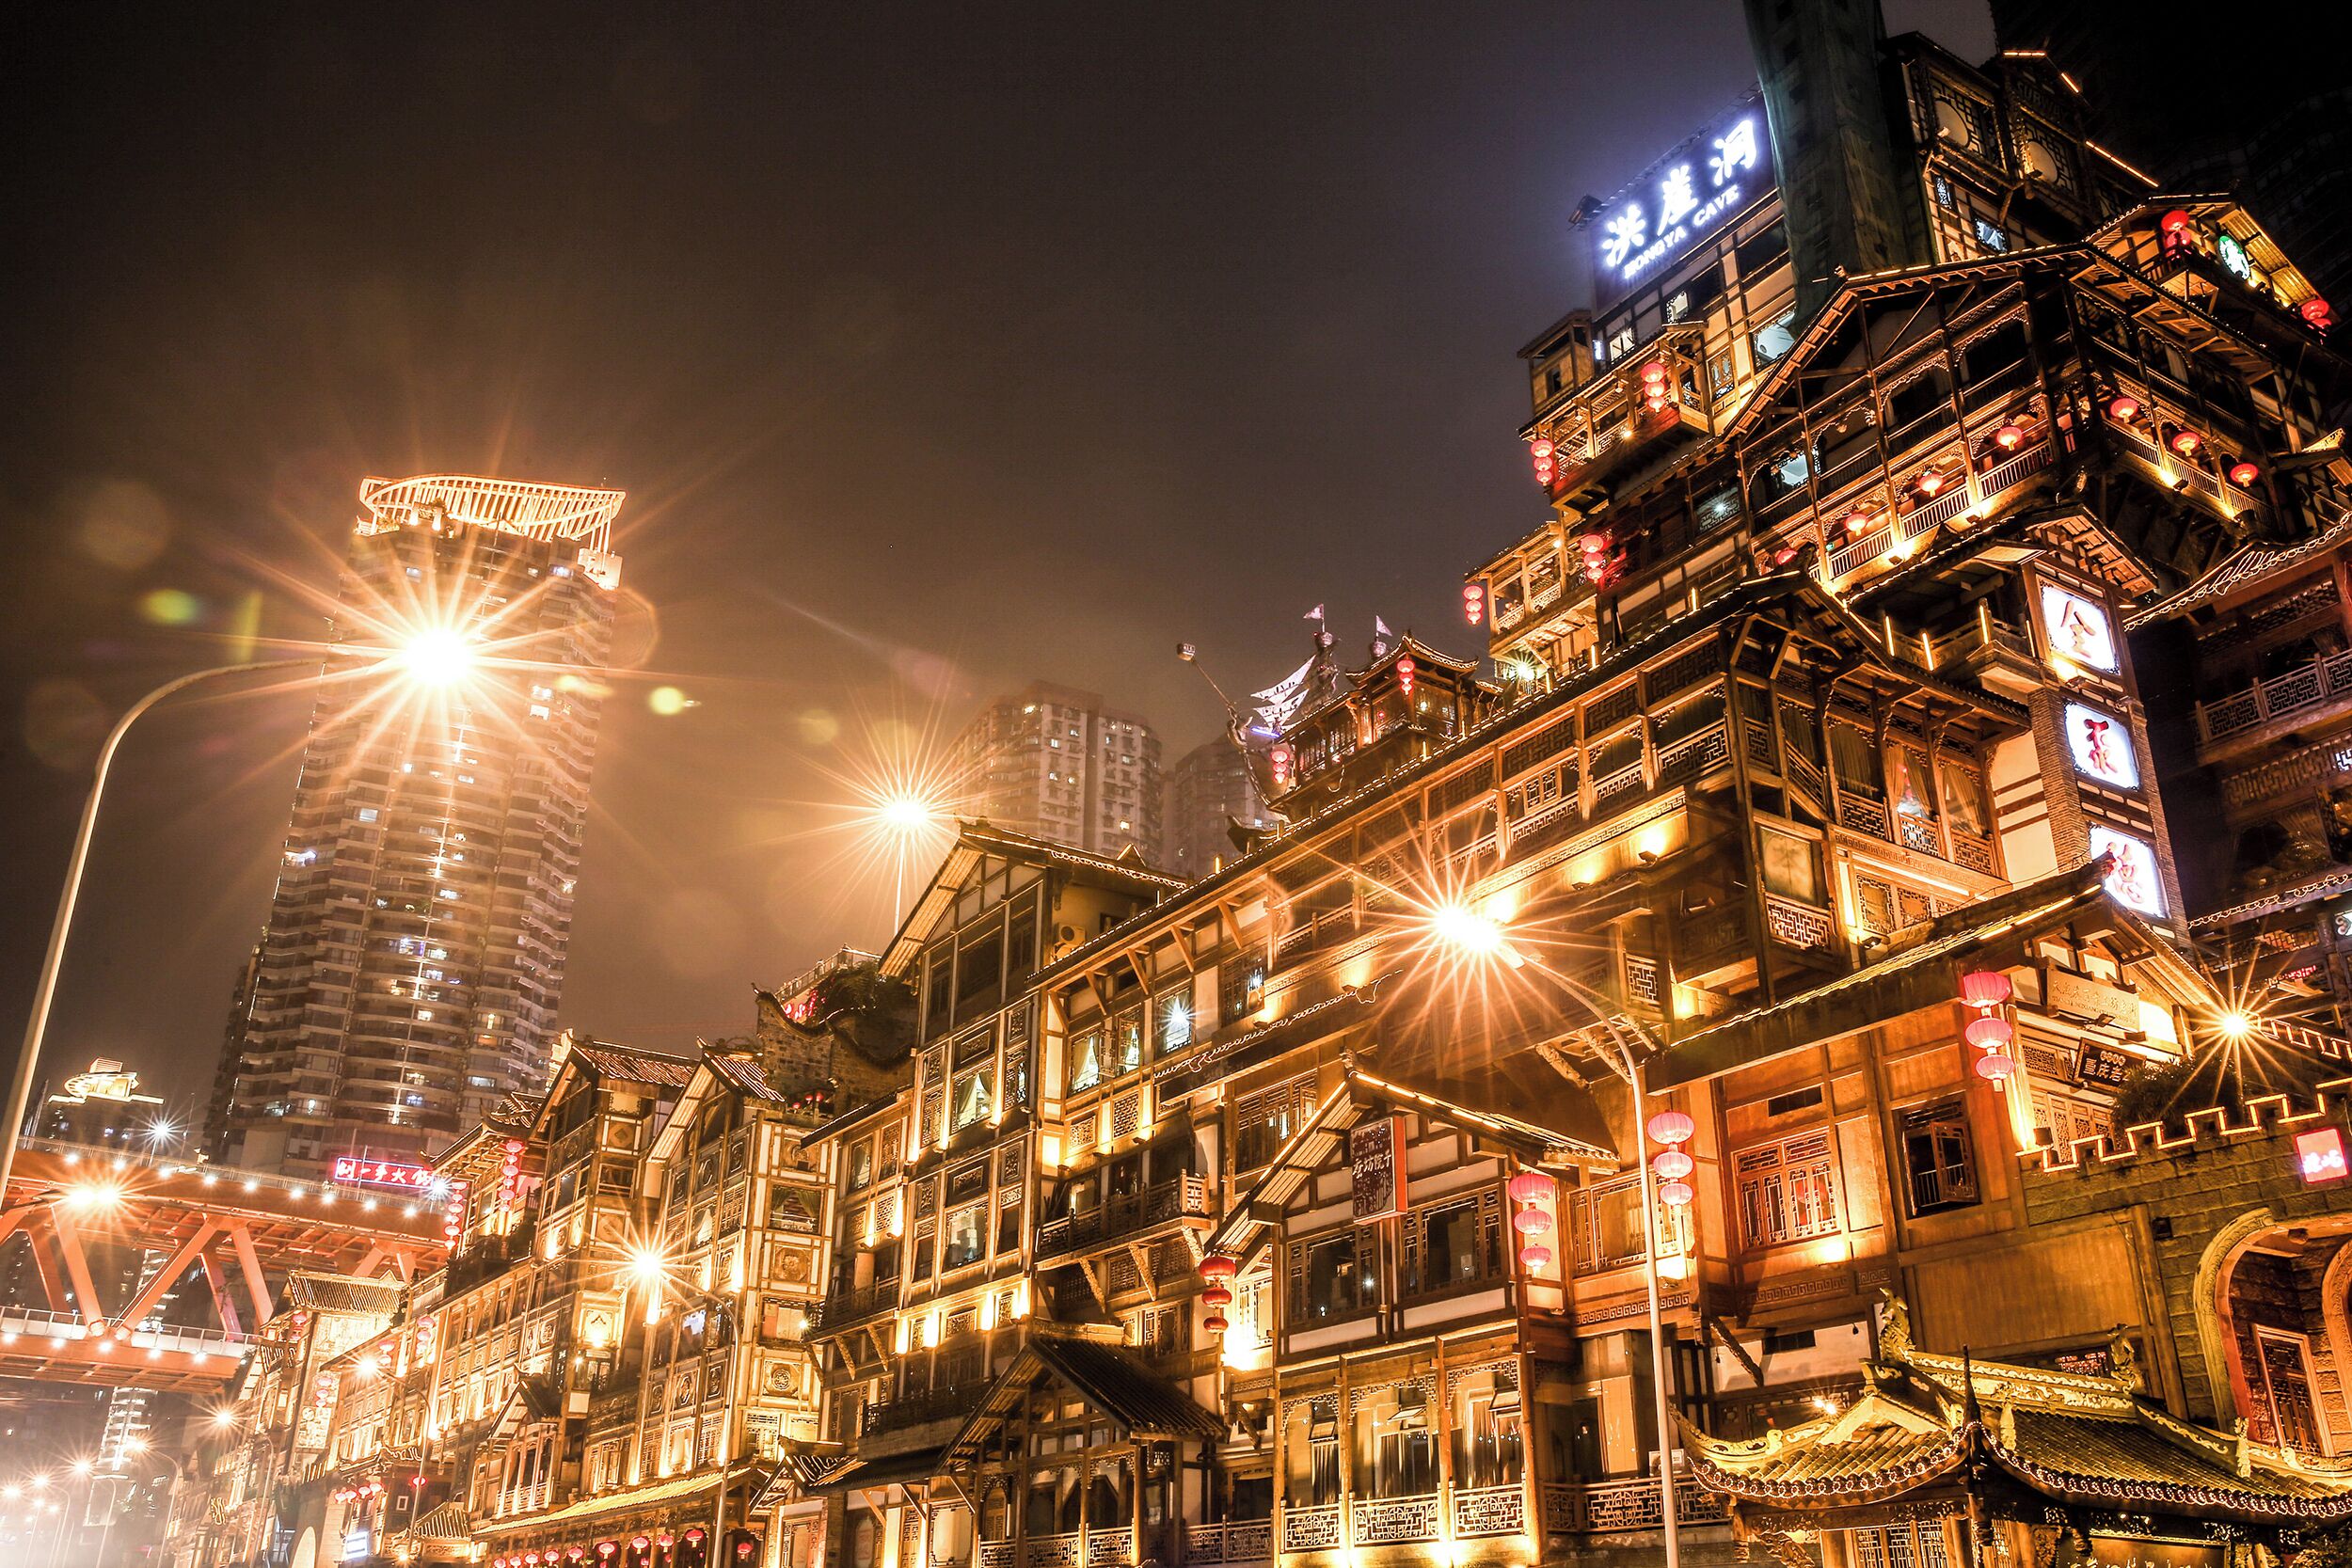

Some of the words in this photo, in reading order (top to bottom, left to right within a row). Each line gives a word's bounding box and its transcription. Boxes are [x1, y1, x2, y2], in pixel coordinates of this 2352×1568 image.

[1602, 119, 1756, 267] 洪崖洞
[1625, 226, 1687, 279] HONGYA
[1692, 184, 1740, 227] CAVE
